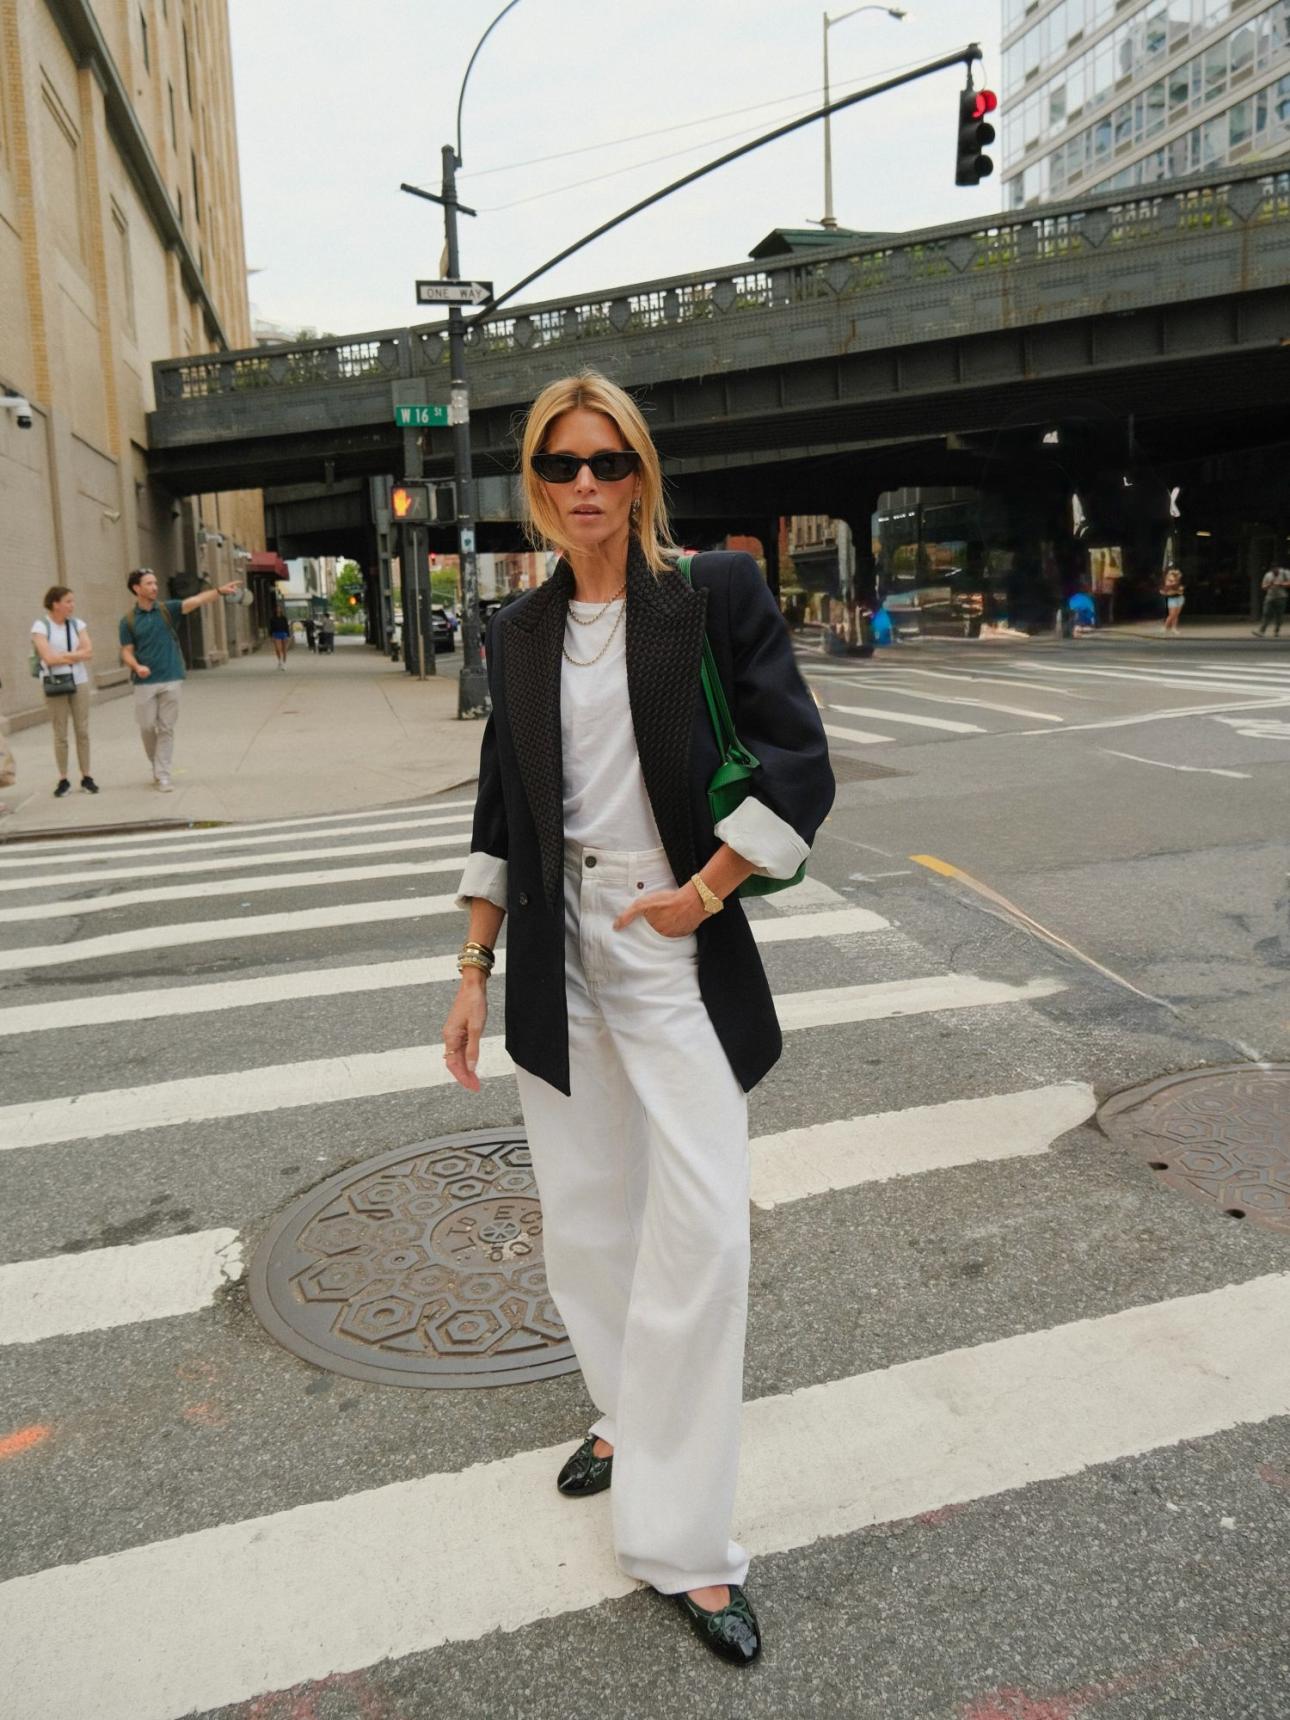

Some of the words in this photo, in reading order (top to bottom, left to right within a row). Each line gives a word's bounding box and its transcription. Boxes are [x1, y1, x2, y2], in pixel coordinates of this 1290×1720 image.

[427, 288, 449, 299] ONE
[459, 288, 483, 299] WAY
[400, 408, 411, 423] W
[415, 408, 429, 423] 16
